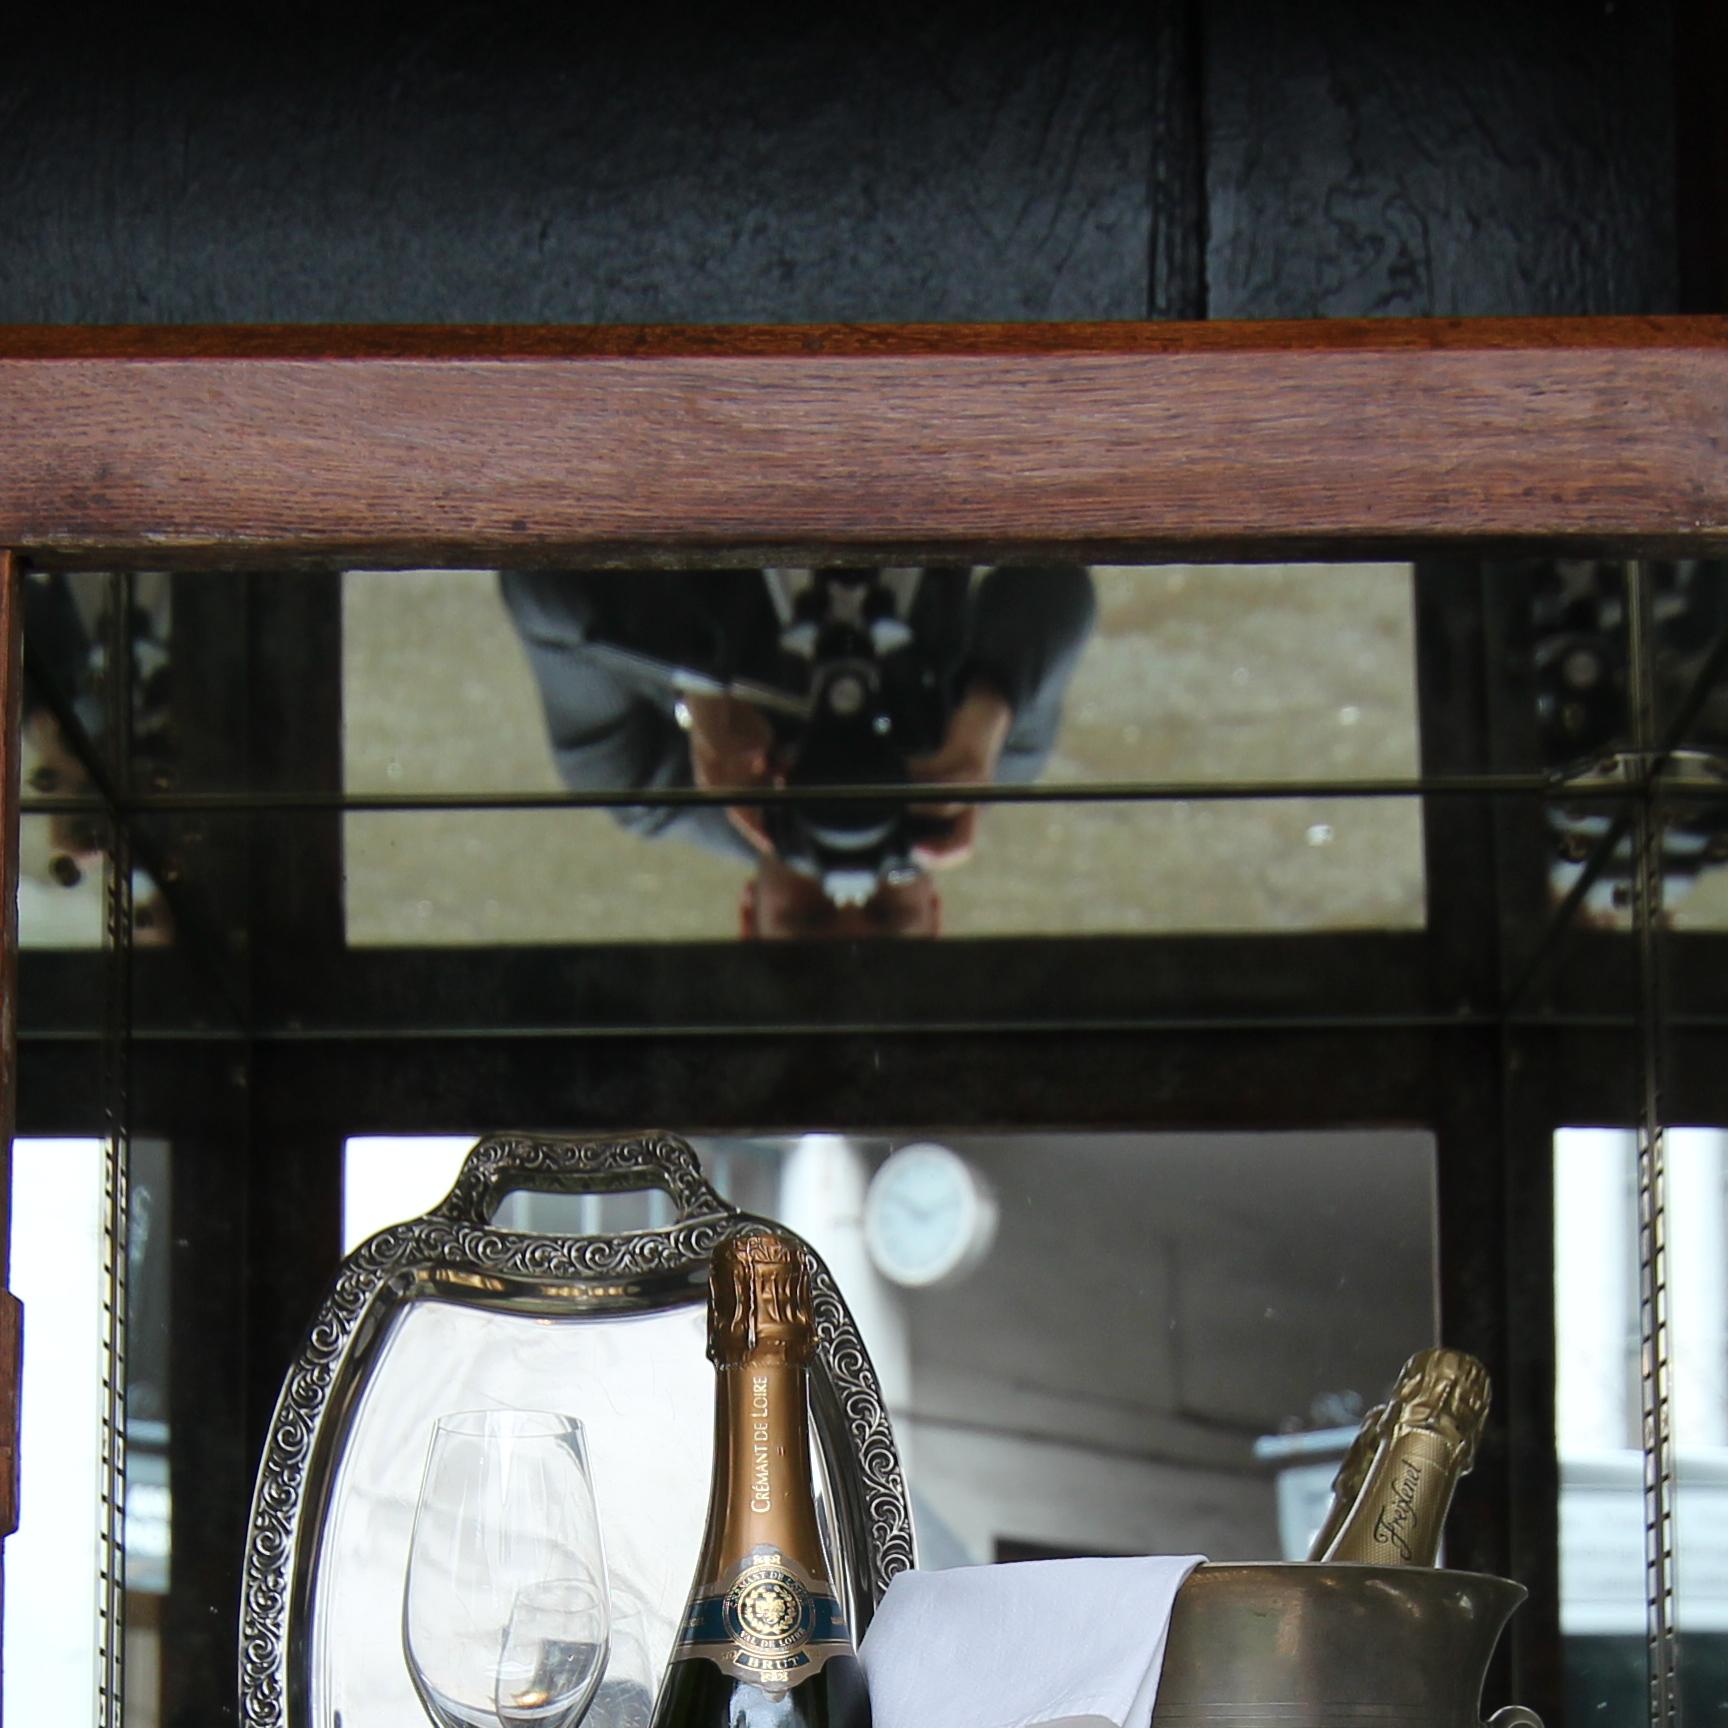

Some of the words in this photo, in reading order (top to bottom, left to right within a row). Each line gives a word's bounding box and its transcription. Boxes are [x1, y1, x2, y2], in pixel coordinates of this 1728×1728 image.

[752, 1376, 768, 1418] LOIRE
[754, 1422, 768, 1441] DE
[751, 1445, 770, 1513] CRÉMANT
[747, 1656, 799, 1670] BRUT
